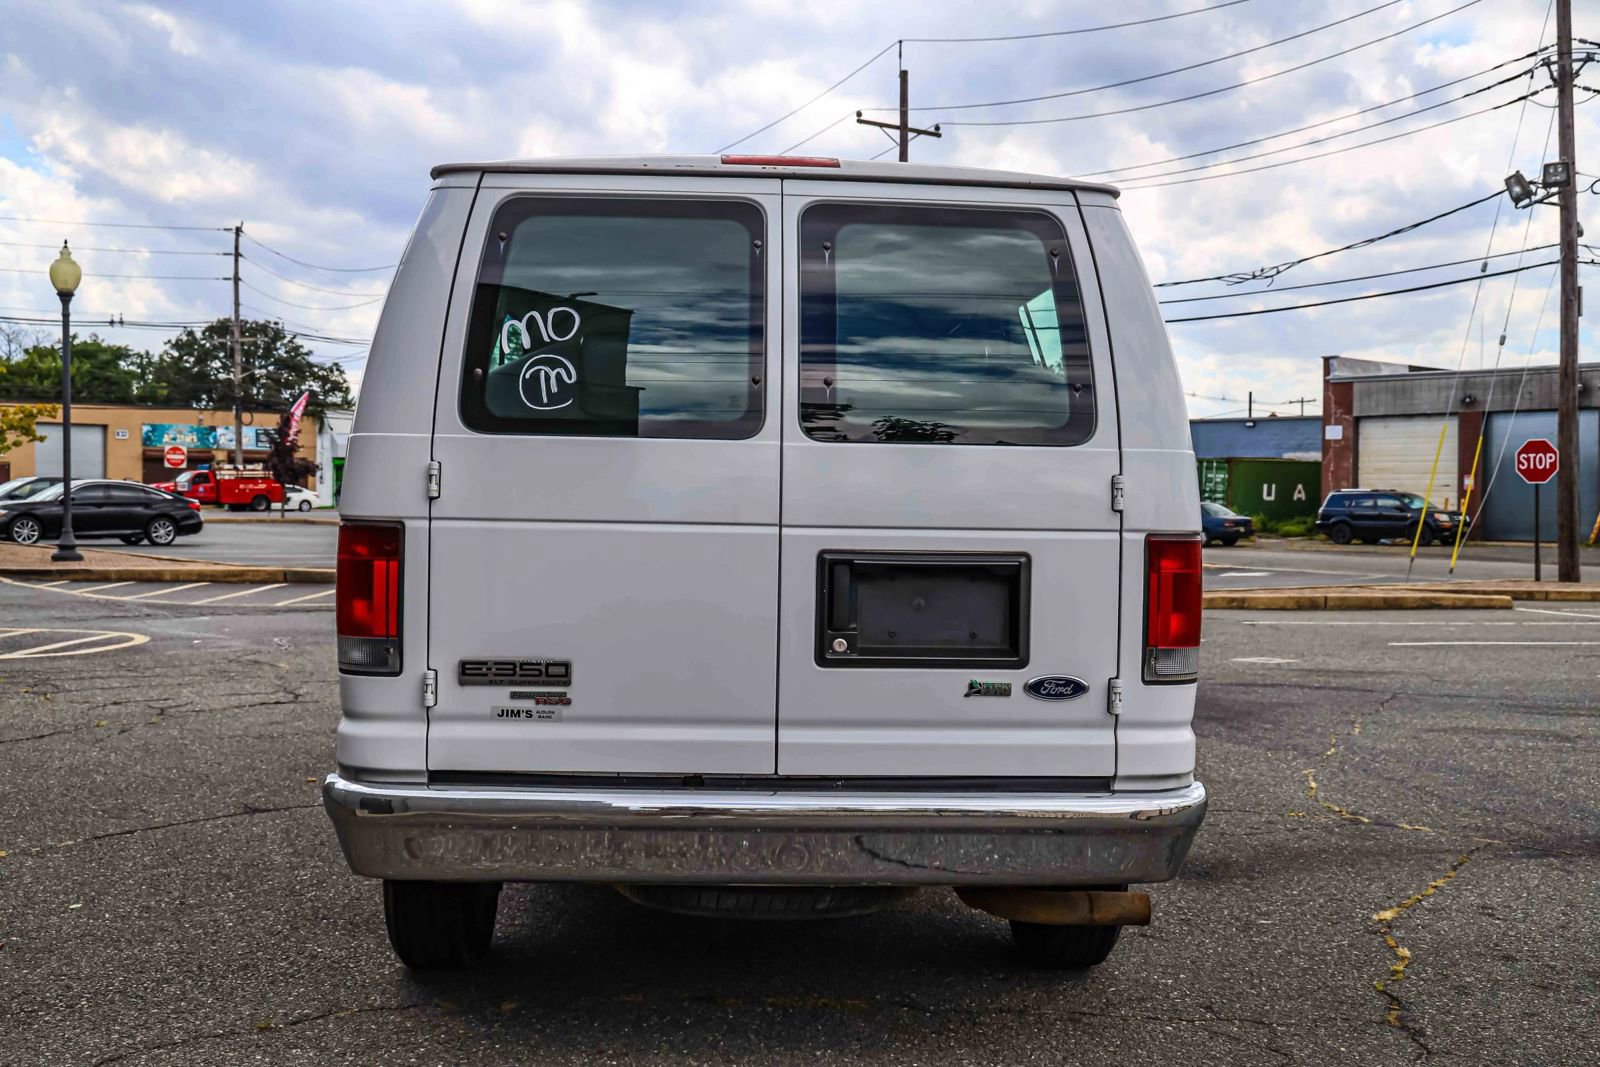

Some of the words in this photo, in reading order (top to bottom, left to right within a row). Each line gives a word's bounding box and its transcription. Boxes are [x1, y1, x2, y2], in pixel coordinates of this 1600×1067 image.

[1518, 453, 1556, 470] STOP
[1262, 483, 1276, 501] U
[1293, 483, 1306, 501] A
[1040, 680, 1074, 695] Ford
[497, 709, 533, 719] JIM'S
